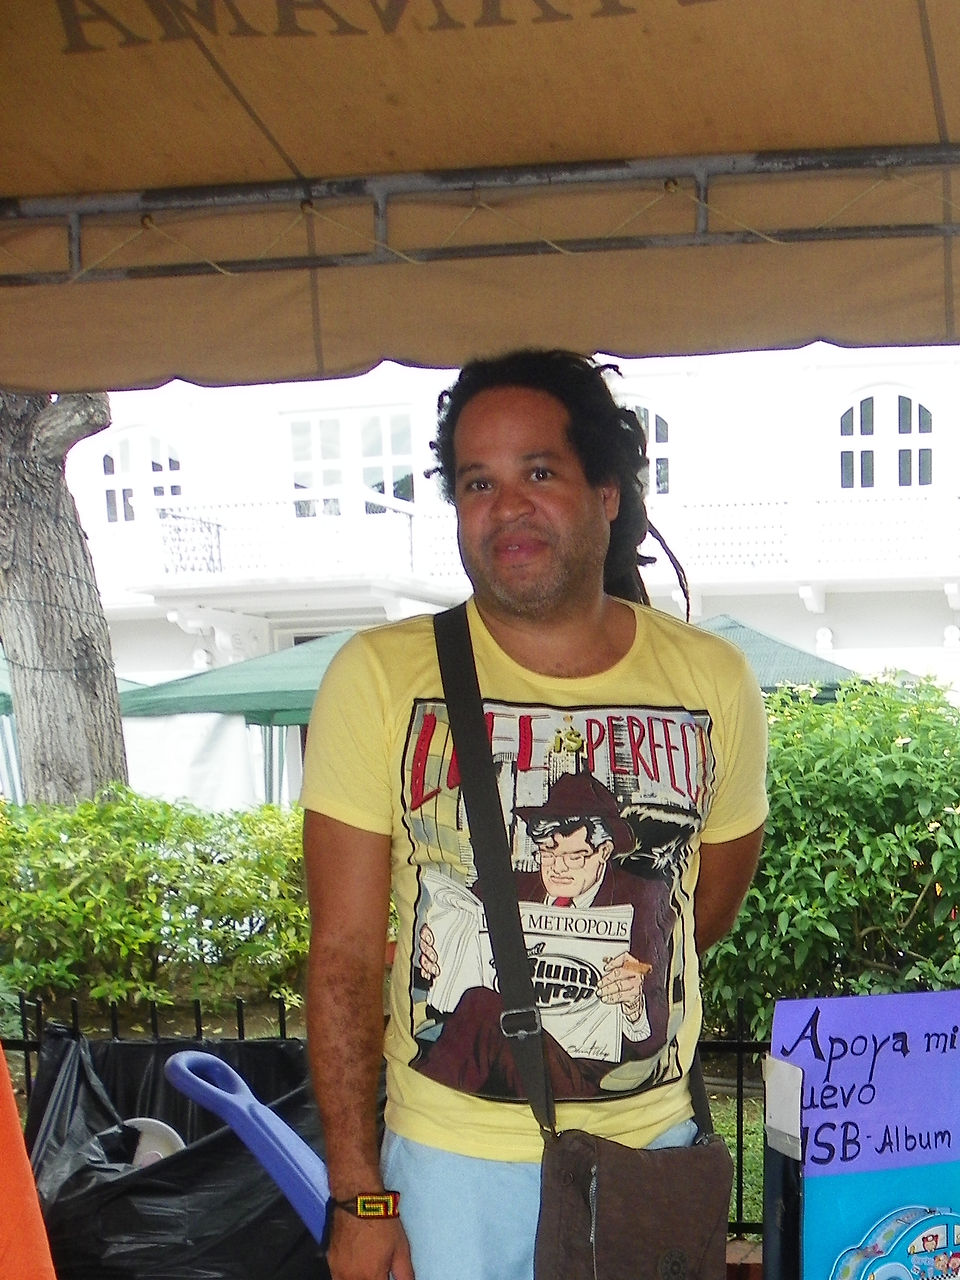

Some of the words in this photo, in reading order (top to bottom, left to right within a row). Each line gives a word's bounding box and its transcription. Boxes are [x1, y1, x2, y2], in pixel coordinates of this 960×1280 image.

[528, 914, 628, 937] METROPOLIS
[781, 1005, 911, 1083] Apoya
[924, 1026, 960, 1054] mi
[801, 1083, 876, 1110] uevo
